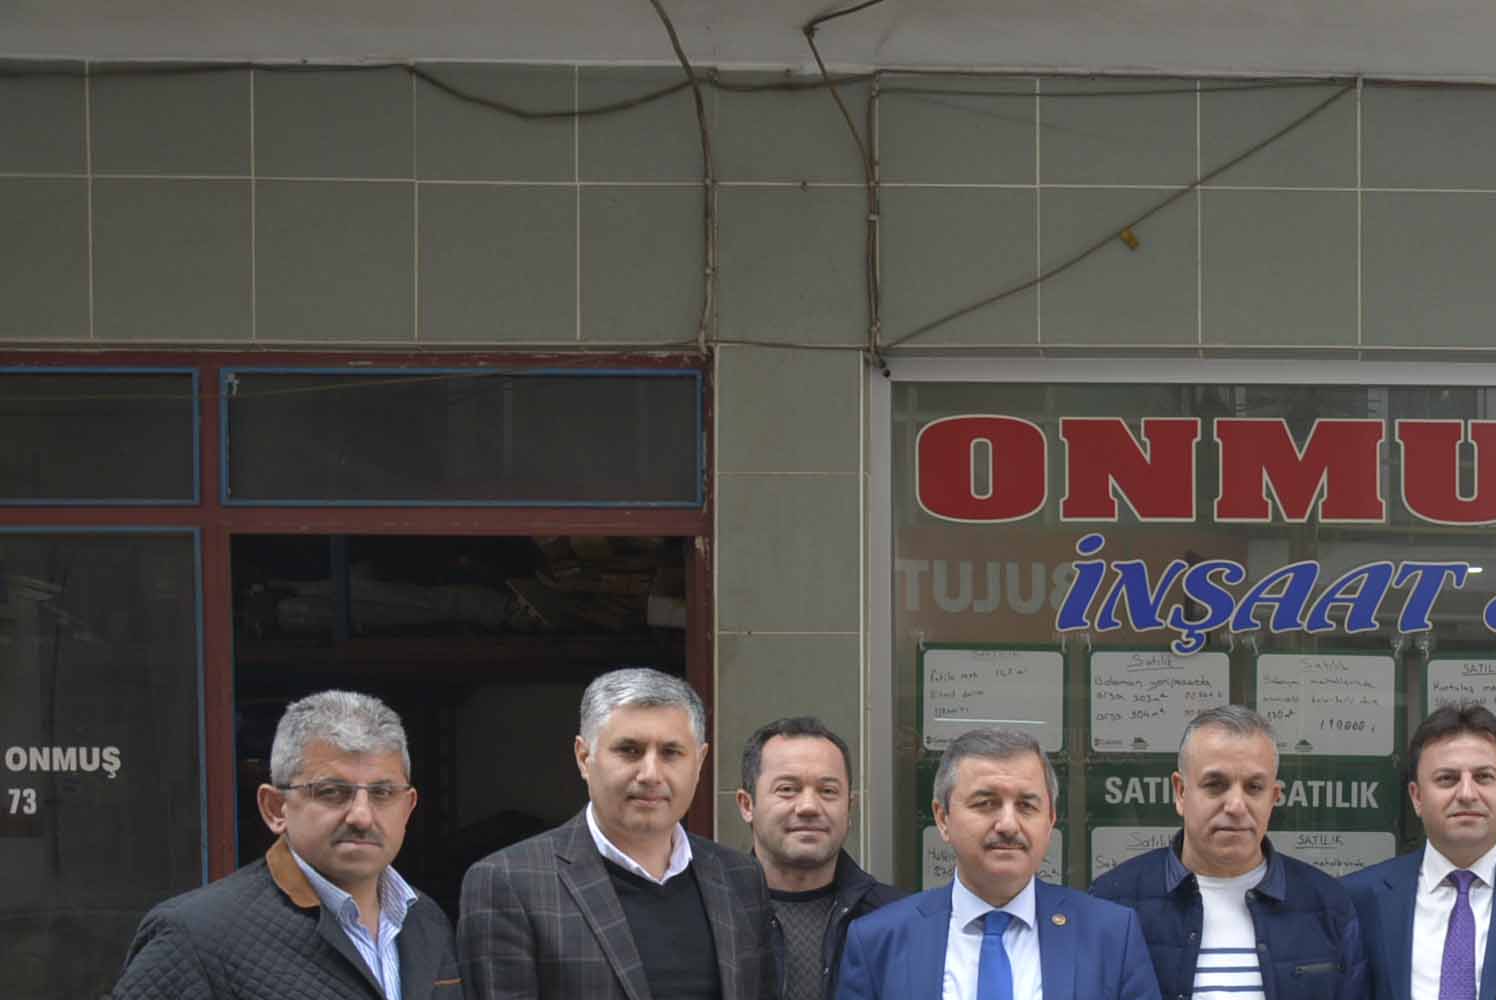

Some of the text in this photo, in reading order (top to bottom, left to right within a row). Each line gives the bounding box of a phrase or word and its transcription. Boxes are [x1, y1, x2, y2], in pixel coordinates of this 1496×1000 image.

[1054, 532, 1470, 656] İNŞAAT
[5, 745, 121, 779] ONMUŞ
[8, 788, 37, 815] 73
[1104, 775, 1176, 805] SATI
